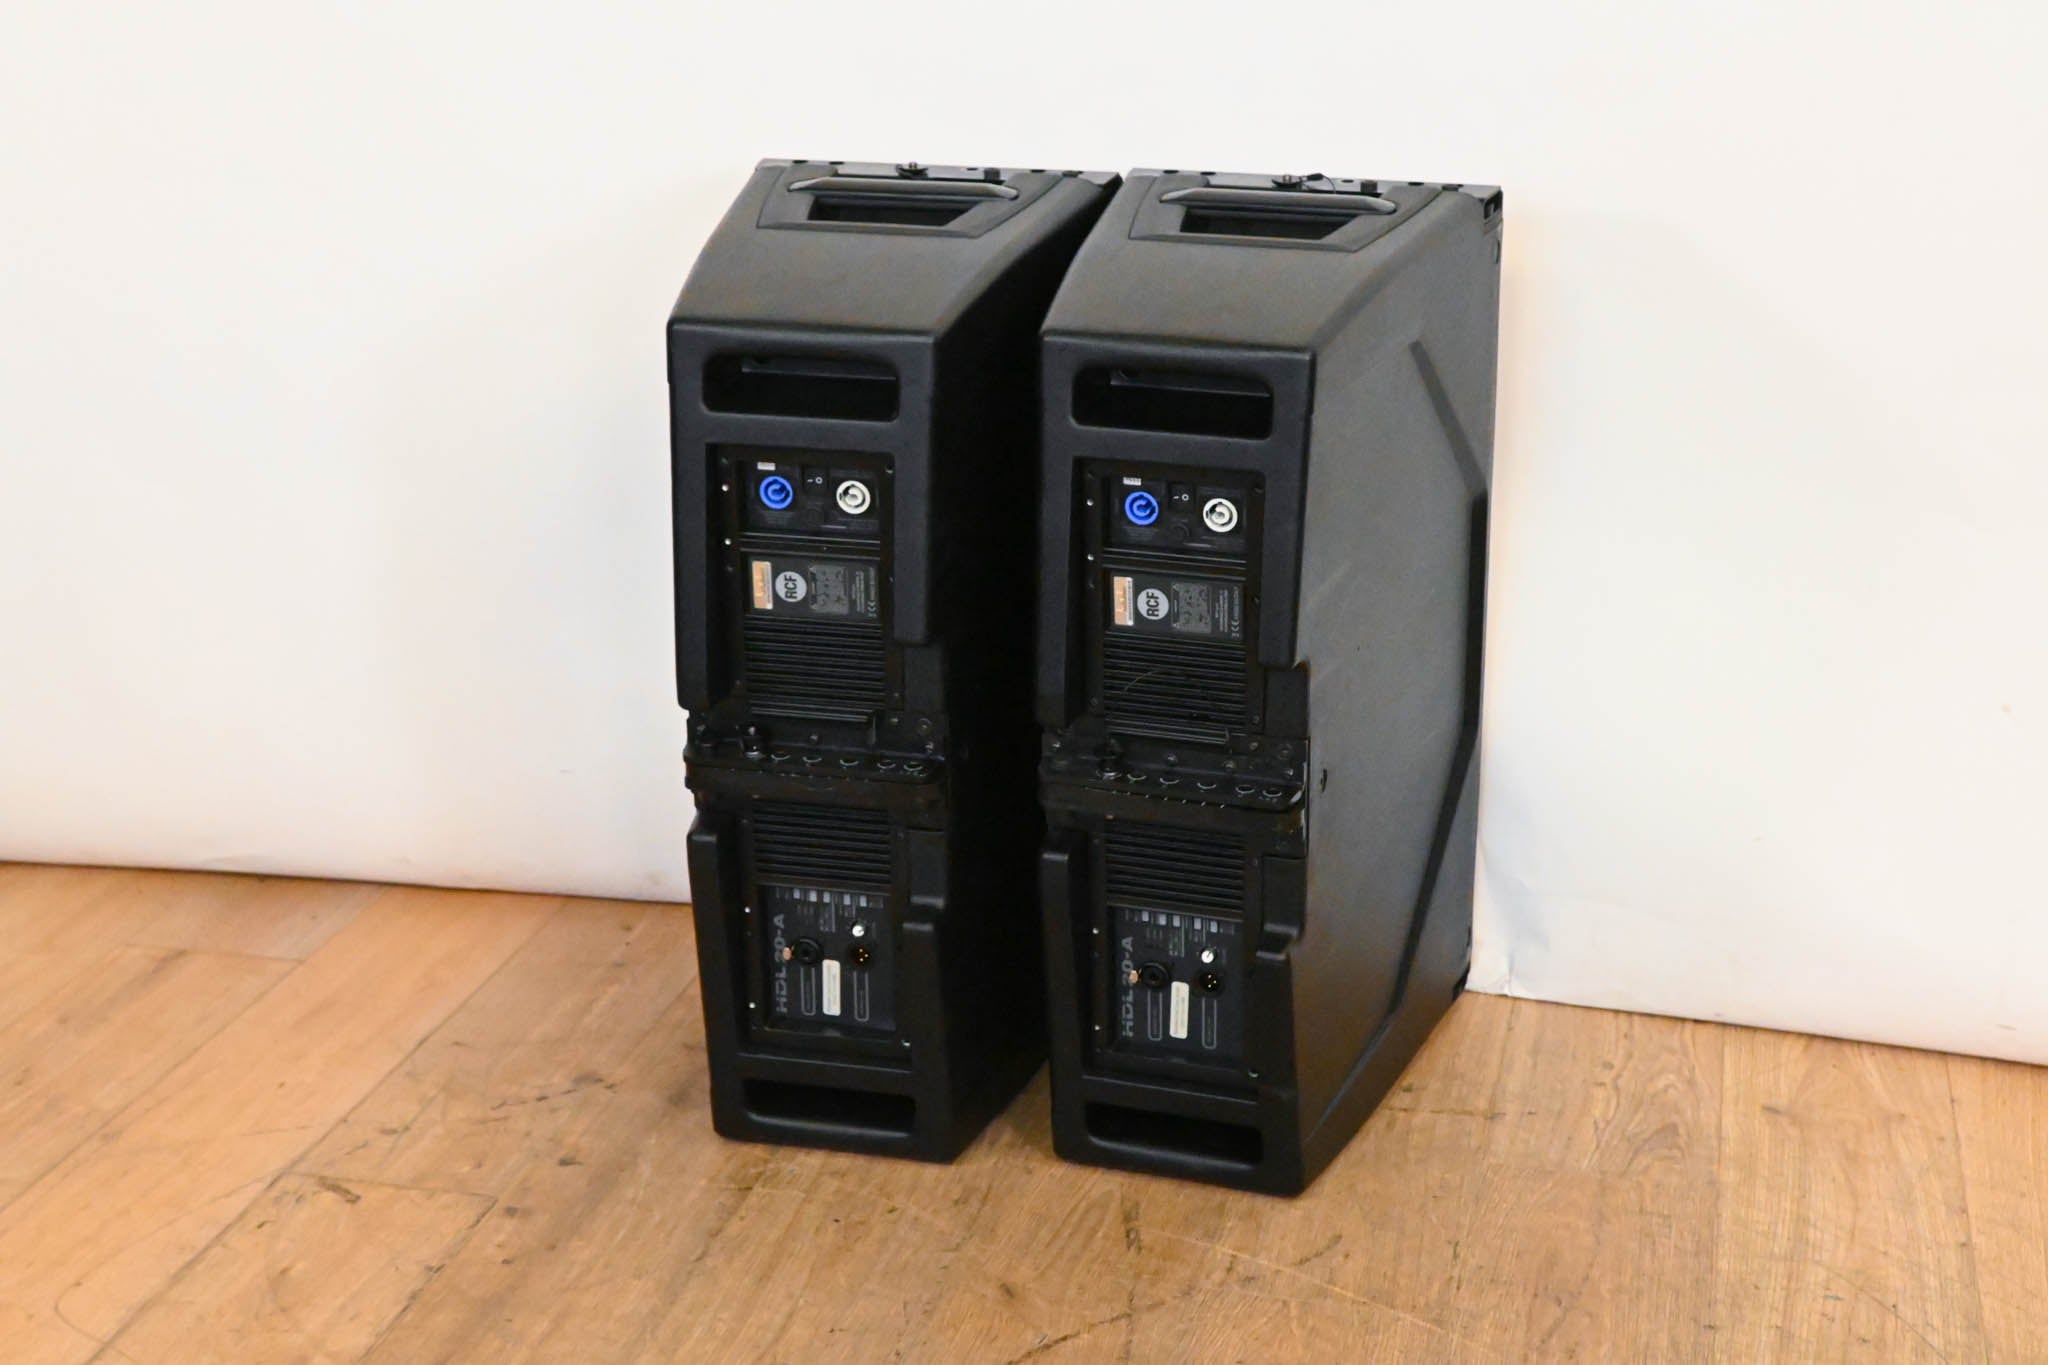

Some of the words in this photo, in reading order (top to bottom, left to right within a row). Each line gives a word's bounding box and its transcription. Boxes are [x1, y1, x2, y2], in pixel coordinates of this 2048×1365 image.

[784, 574, 798, 600] RCF
[1146, 591, 1160, 617] RCF
[775, 965, 788, 1013] HDL
[1121, 986, 1134, 1038] HDL
